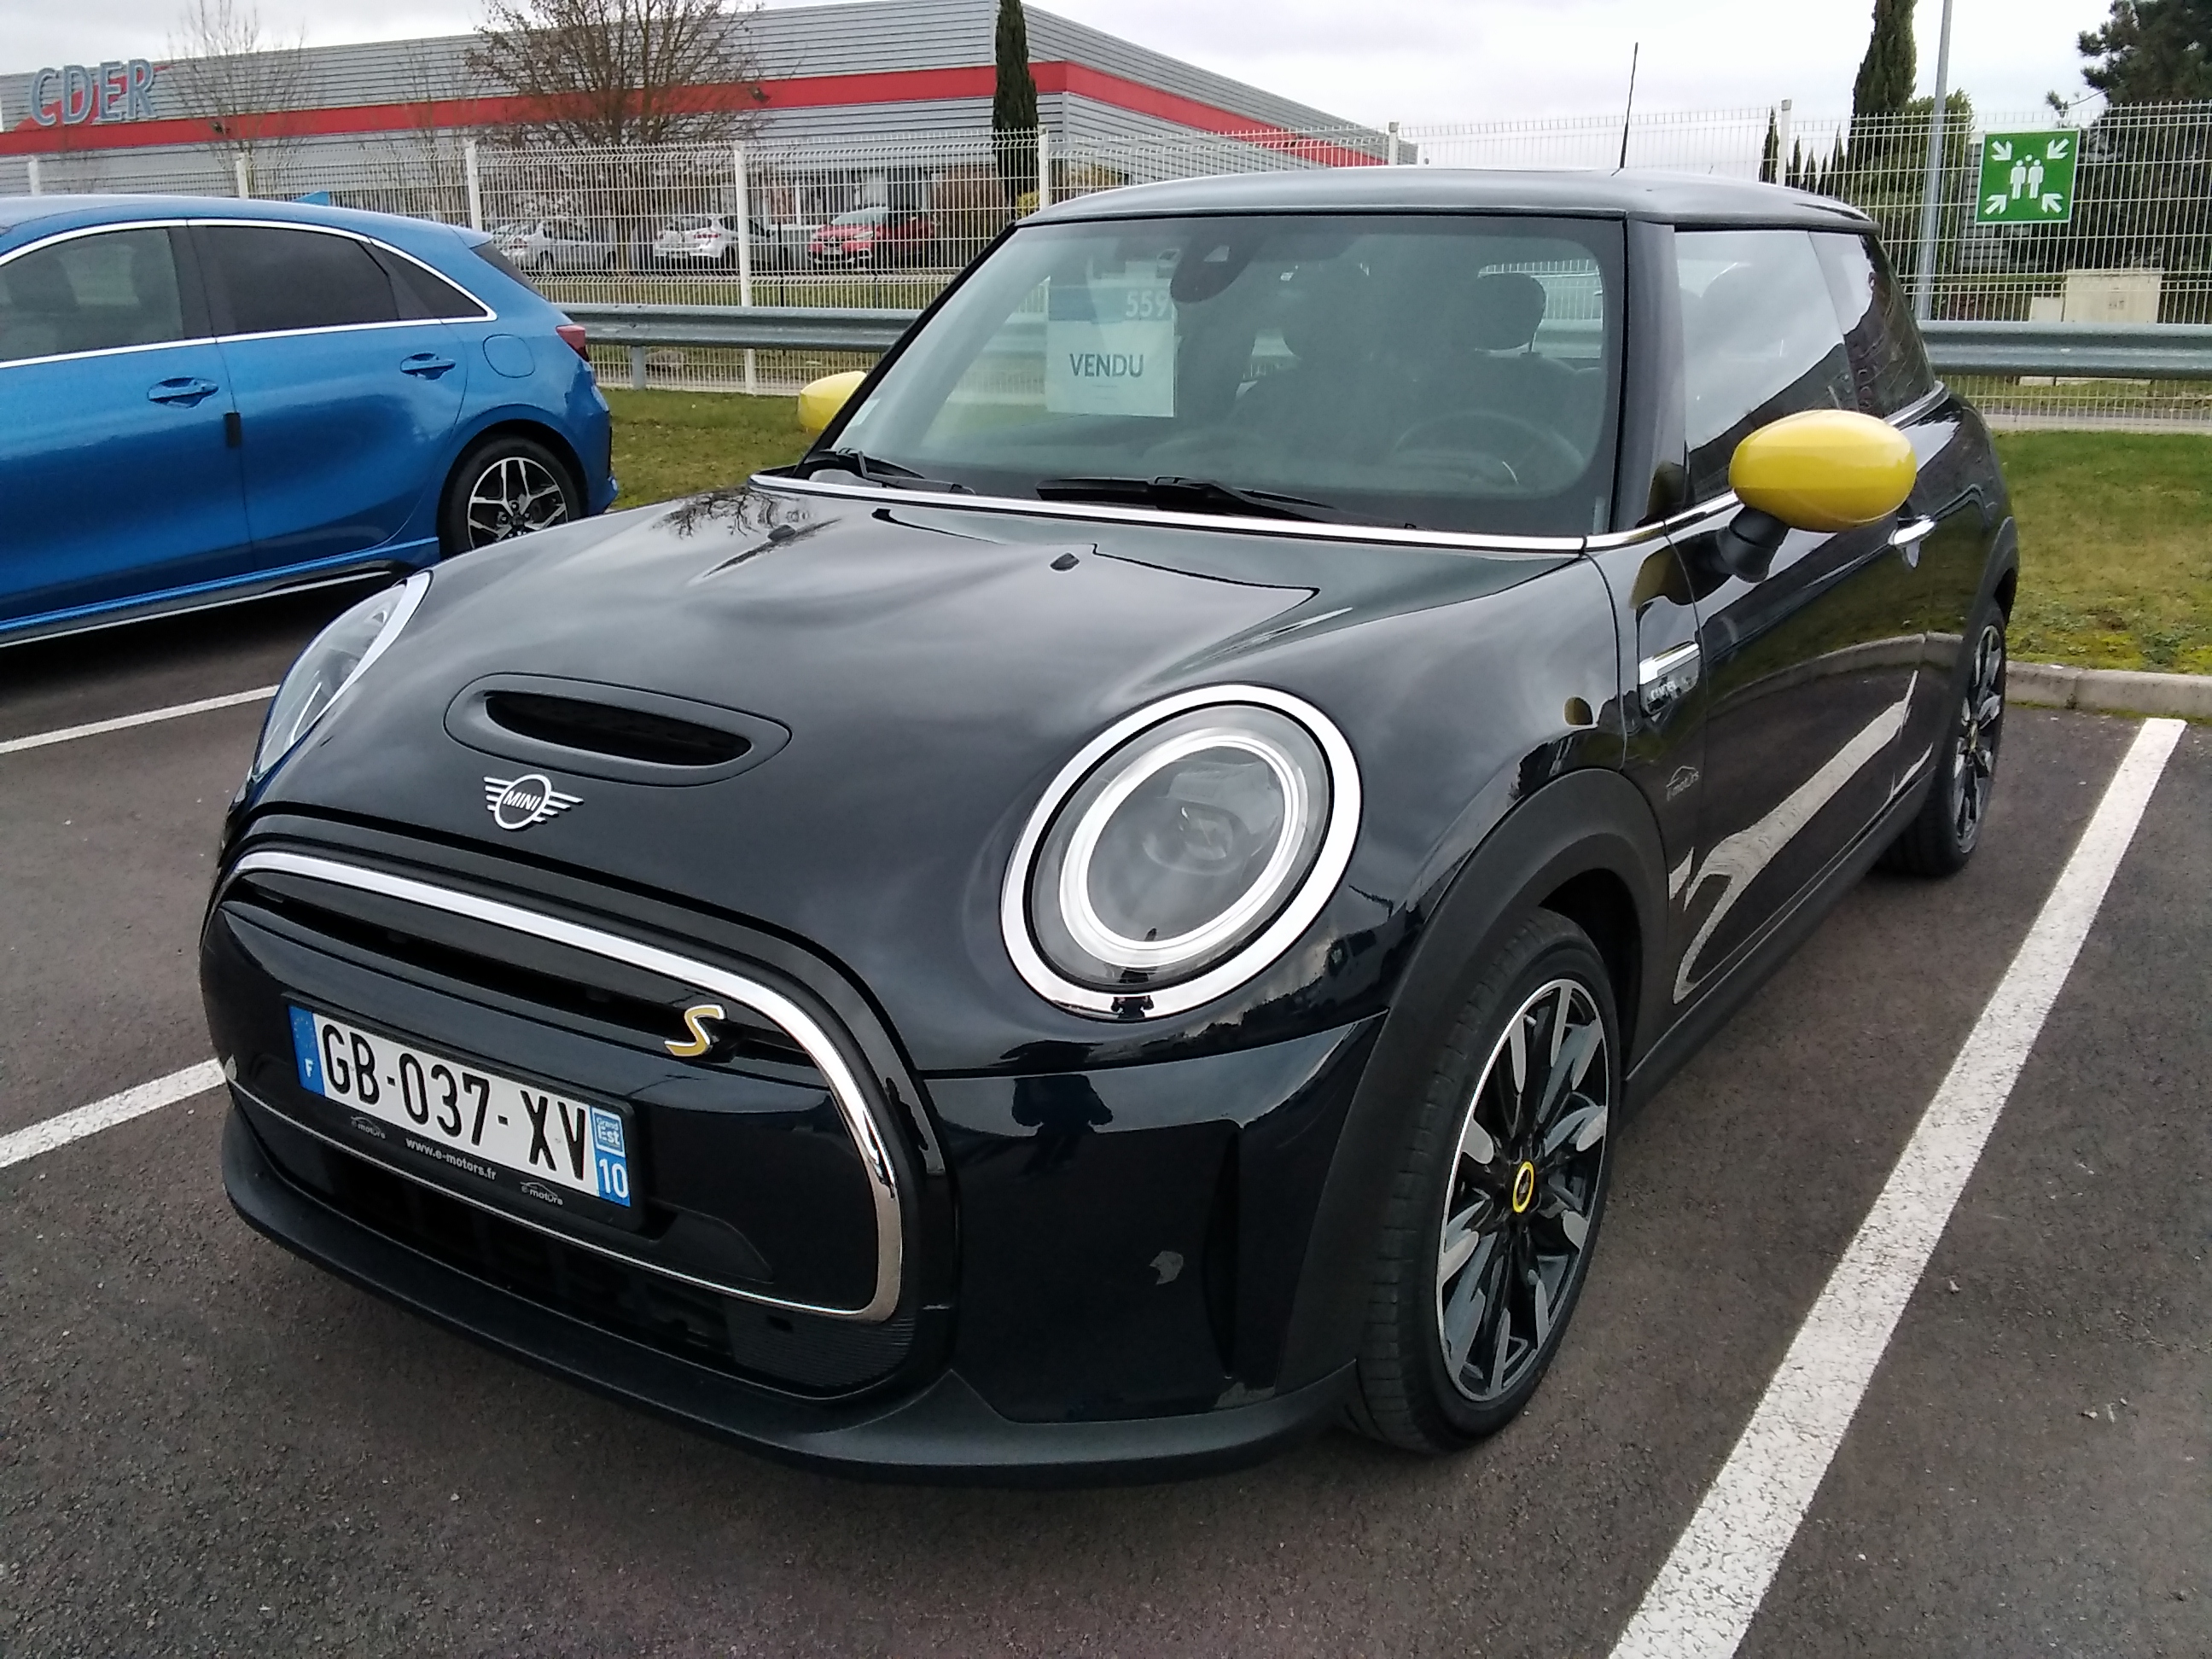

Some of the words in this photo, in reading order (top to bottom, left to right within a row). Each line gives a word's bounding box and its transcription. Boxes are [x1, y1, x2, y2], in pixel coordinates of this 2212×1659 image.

[31, 58, 157, 126] CDER
[1126, 289, 1169, 318] 559
[1069, 353, 1144, 378] VENDU
[503, 790, 542, 812] MINI
[664, 1004, 725, 1057] S
[305, 1057, 314, 1079] F
[598, 1125, 620, 1146] Est
[405, 1138, 497, 1180] www.e-motors.fr
[599, 1158, 629, 1198] 10
